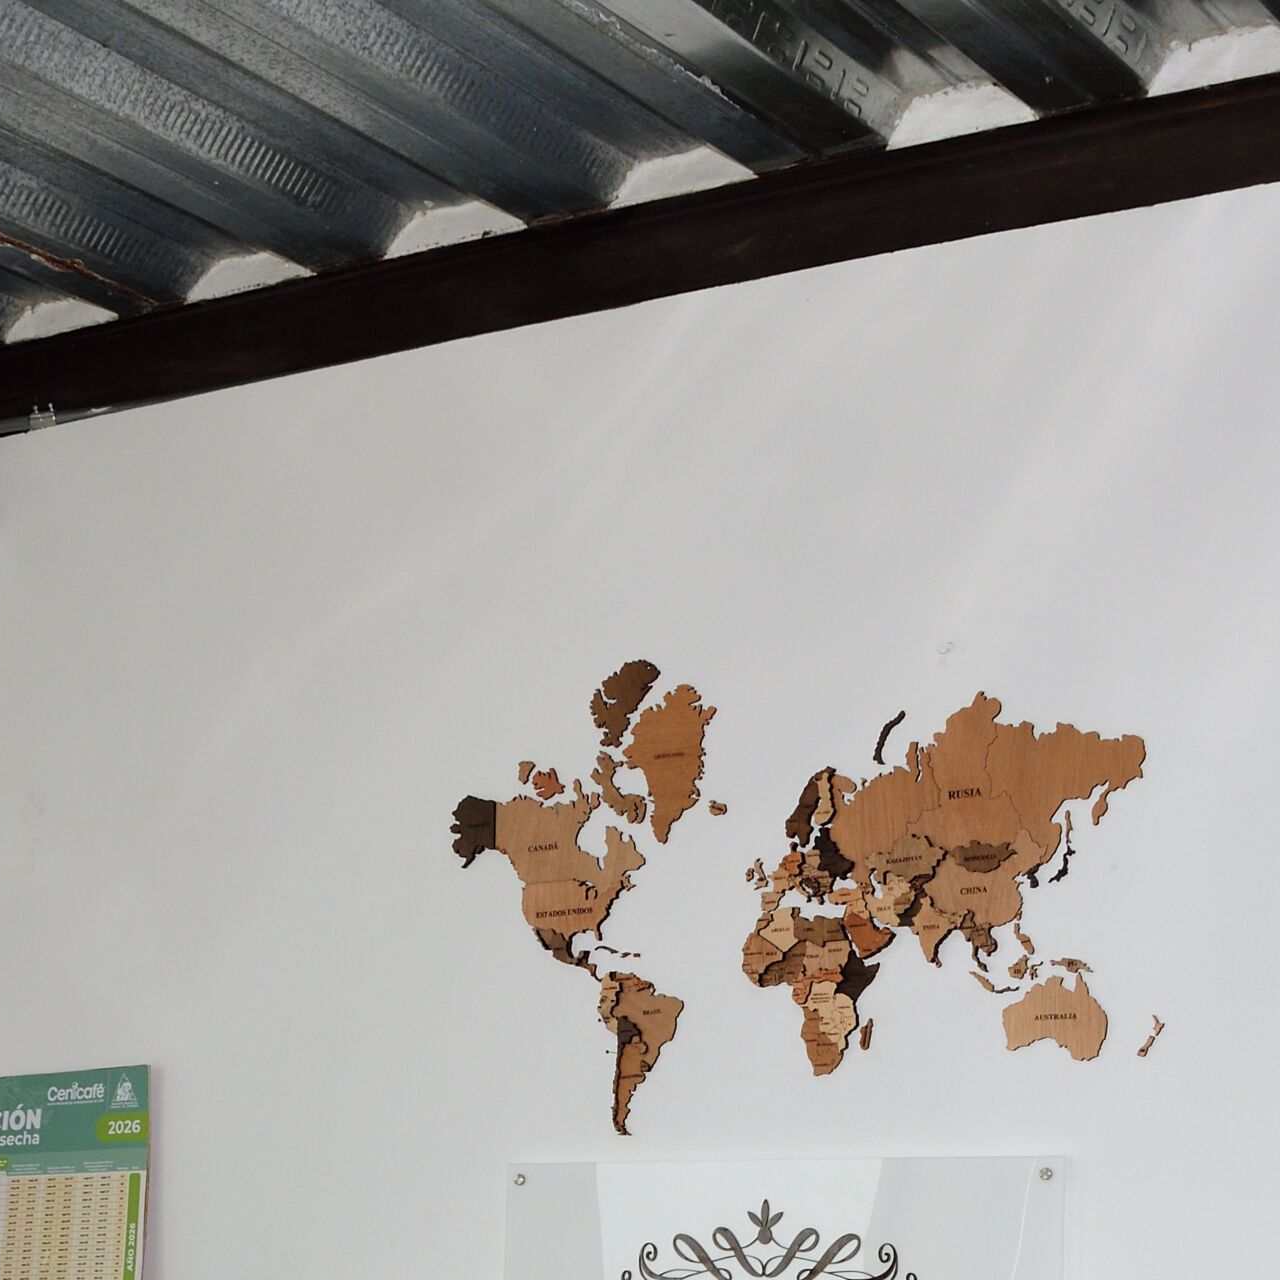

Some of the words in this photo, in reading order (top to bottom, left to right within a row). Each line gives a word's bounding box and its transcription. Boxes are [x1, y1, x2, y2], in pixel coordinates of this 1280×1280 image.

[948, 788, 982, 801] RUSIA
[528, 841, 559, 853] CANADÁ
[960, 886, 988, 896] CHINA
[536, 909, 566, 919] ESTADOS
[568, 906, 593, 916] UNIDOS
[1034, 1013, 1077, 1021] AUSTRALIA
[47, 1081, 105, 1102] Cenicafé
[108, 1120, 141, 1135] 2026
[128, 1222, 136, 1247] 2026
